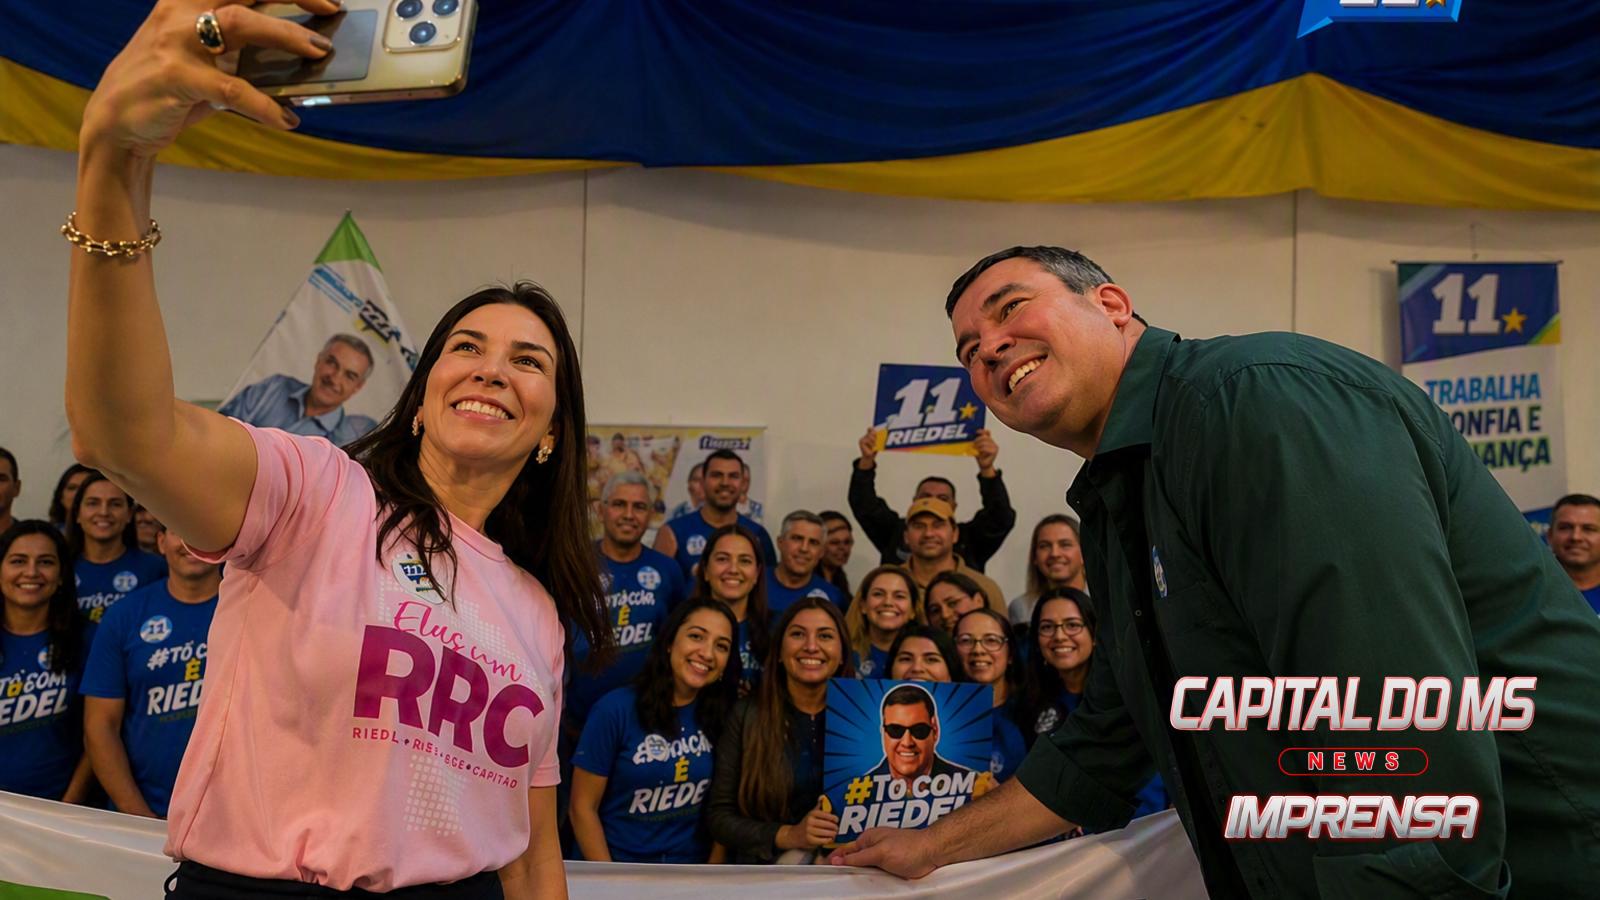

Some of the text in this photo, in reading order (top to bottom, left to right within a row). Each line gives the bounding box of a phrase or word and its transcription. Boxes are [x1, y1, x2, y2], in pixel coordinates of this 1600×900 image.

[1431, 273, 1501, 335] 11
[887, 377, 962, 430] 11
[1424, 373, 1541, 405] TRABALHA
[886, 424, 968, 446] RIEDEL
[1446, 405, 1541, 436] ONFIA E
[353, 625, 544, 768] RRC
[912, 771, 976, 798] COM
